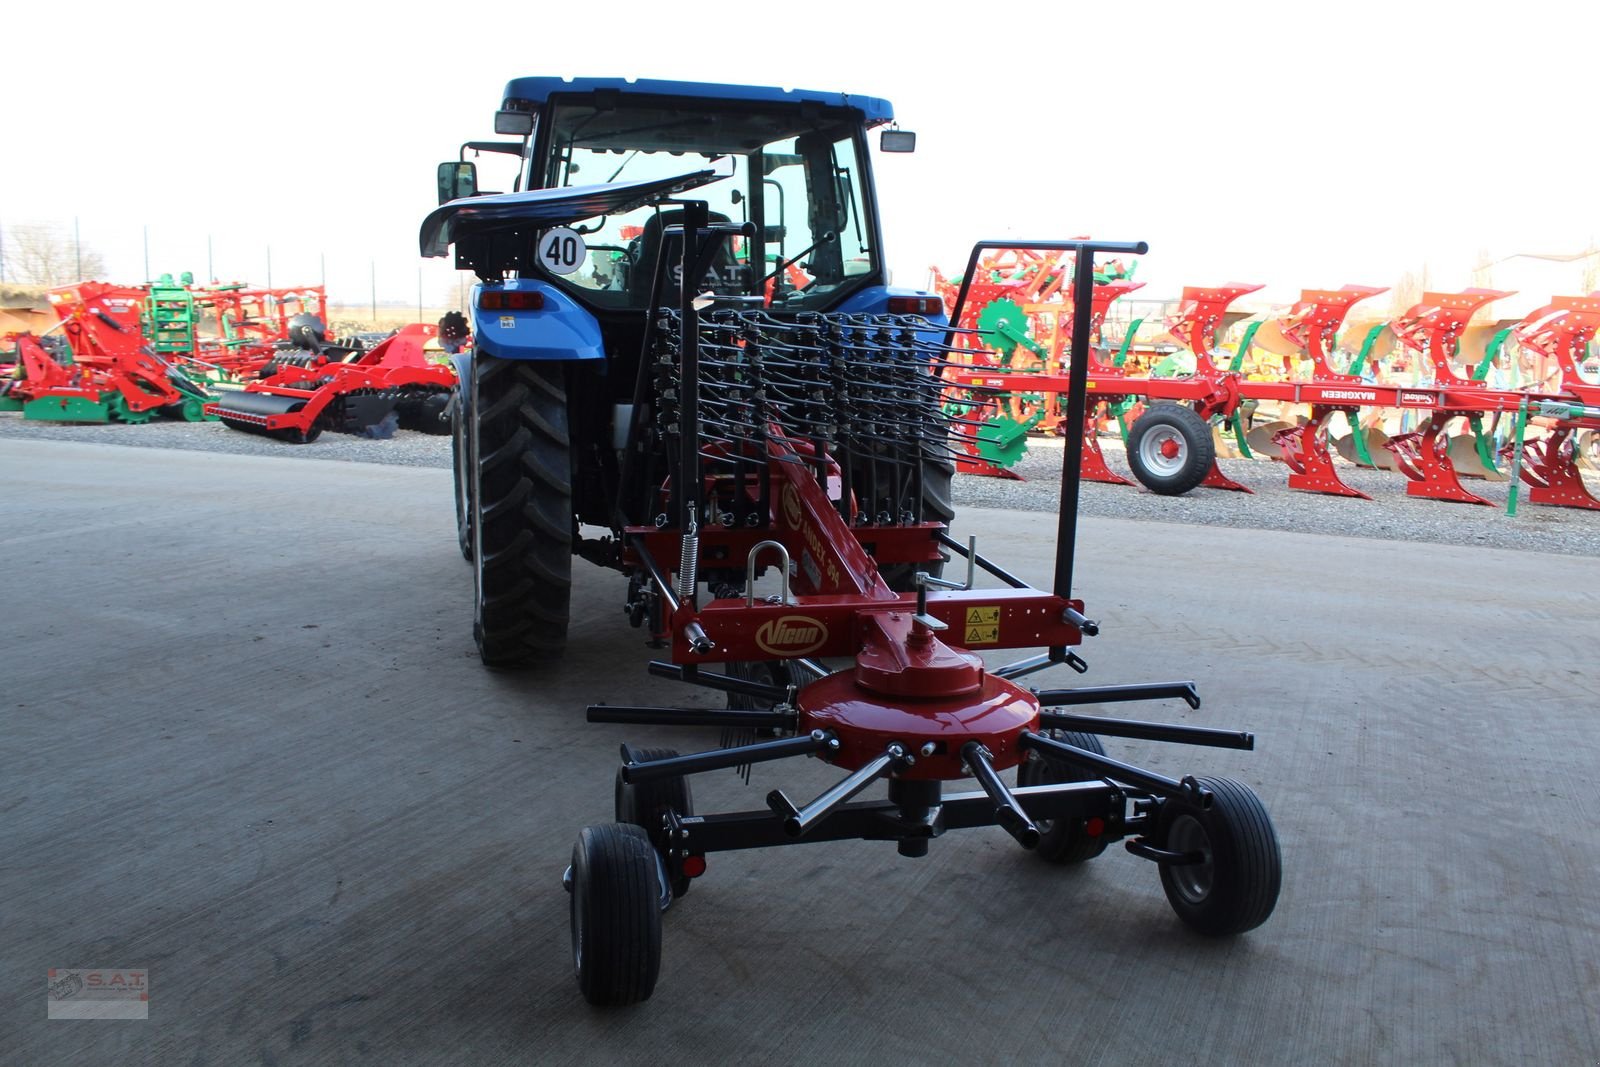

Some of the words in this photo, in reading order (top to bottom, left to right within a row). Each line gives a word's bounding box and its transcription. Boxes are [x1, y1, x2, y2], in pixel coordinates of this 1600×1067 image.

[546, 236, 577, 266] 40
[1321, 389, 1376, 401] MAXGREEN
[803, 520, 826, 566] ANDEX
[766, 618, 819, 645] Vicon
